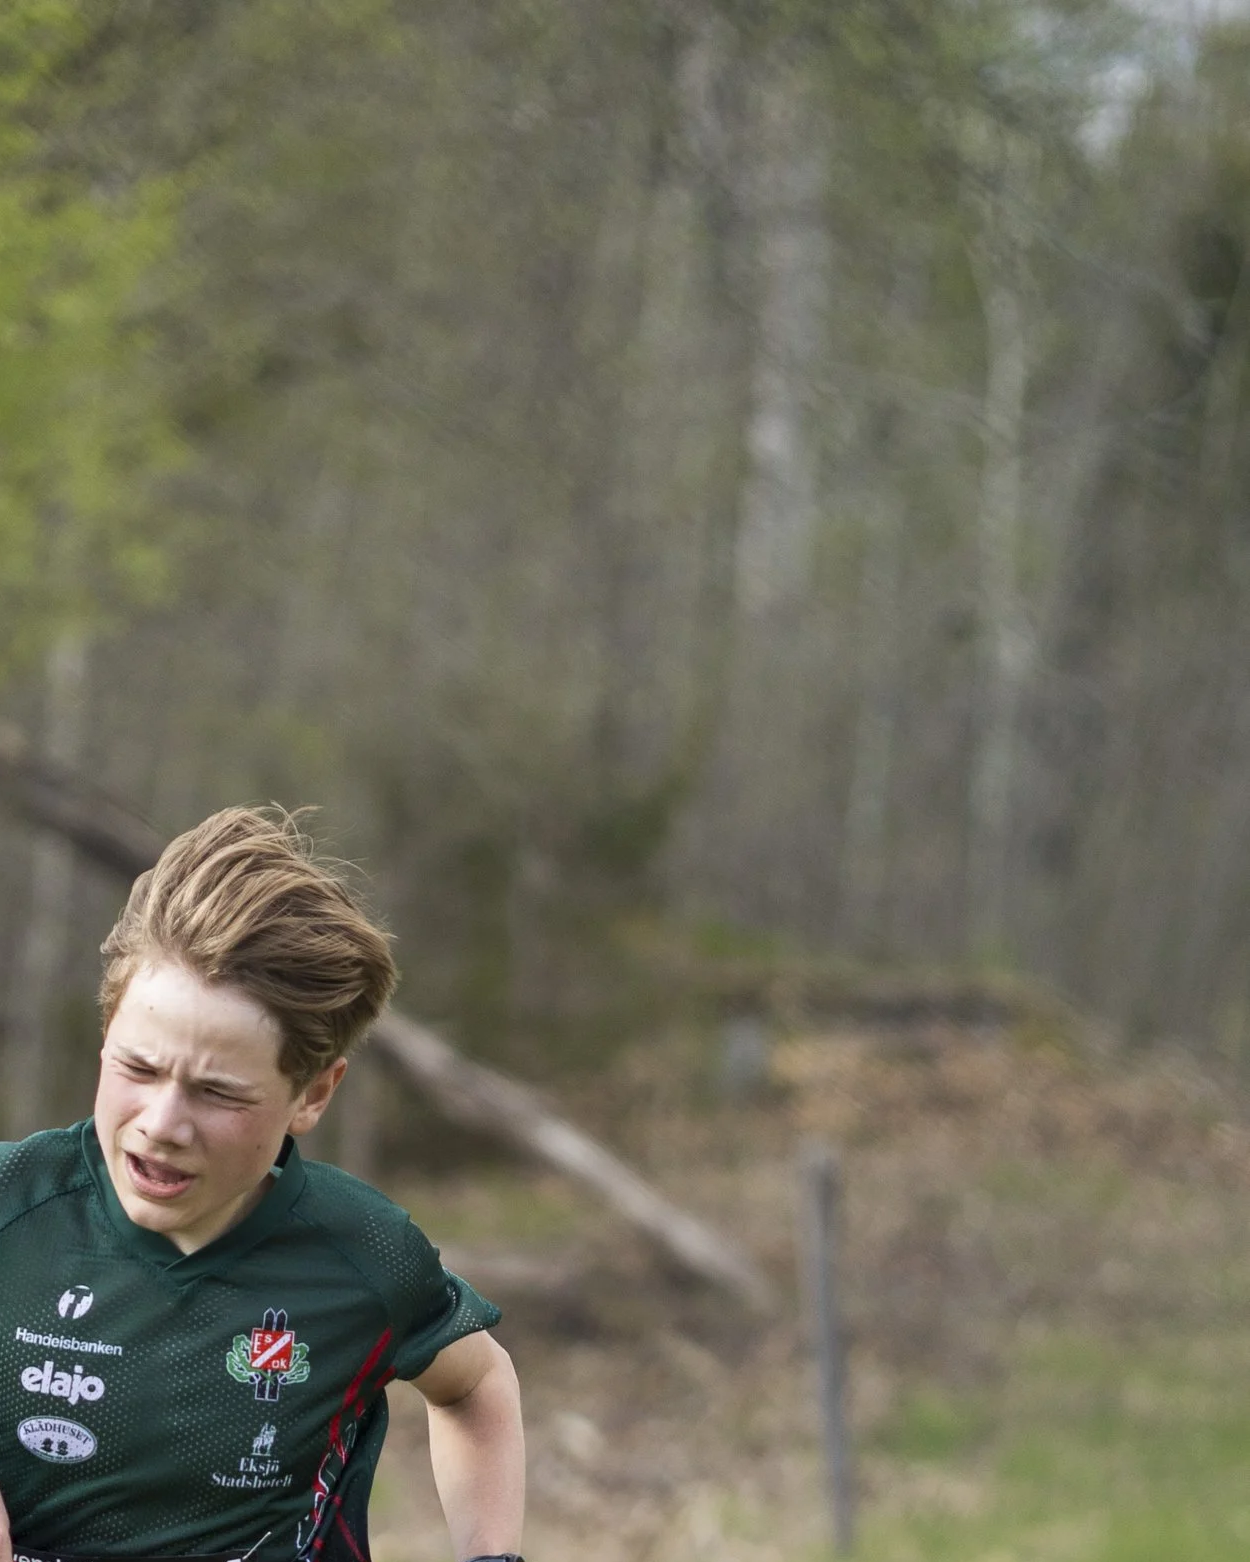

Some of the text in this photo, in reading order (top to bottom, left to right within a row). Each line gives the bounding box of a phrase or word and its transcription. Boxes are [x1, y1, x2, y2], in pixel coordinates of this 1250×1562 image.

[15, 1327, 123, 1356] Handelsbanken
[21, 1360, 105, 1406] elajo
[23, 1421, 92, 1445] KLÄDHUSET
[239, 1457, 280, 1477] Eksjö
[211, 1472, 293, 1489] Stadshotell
